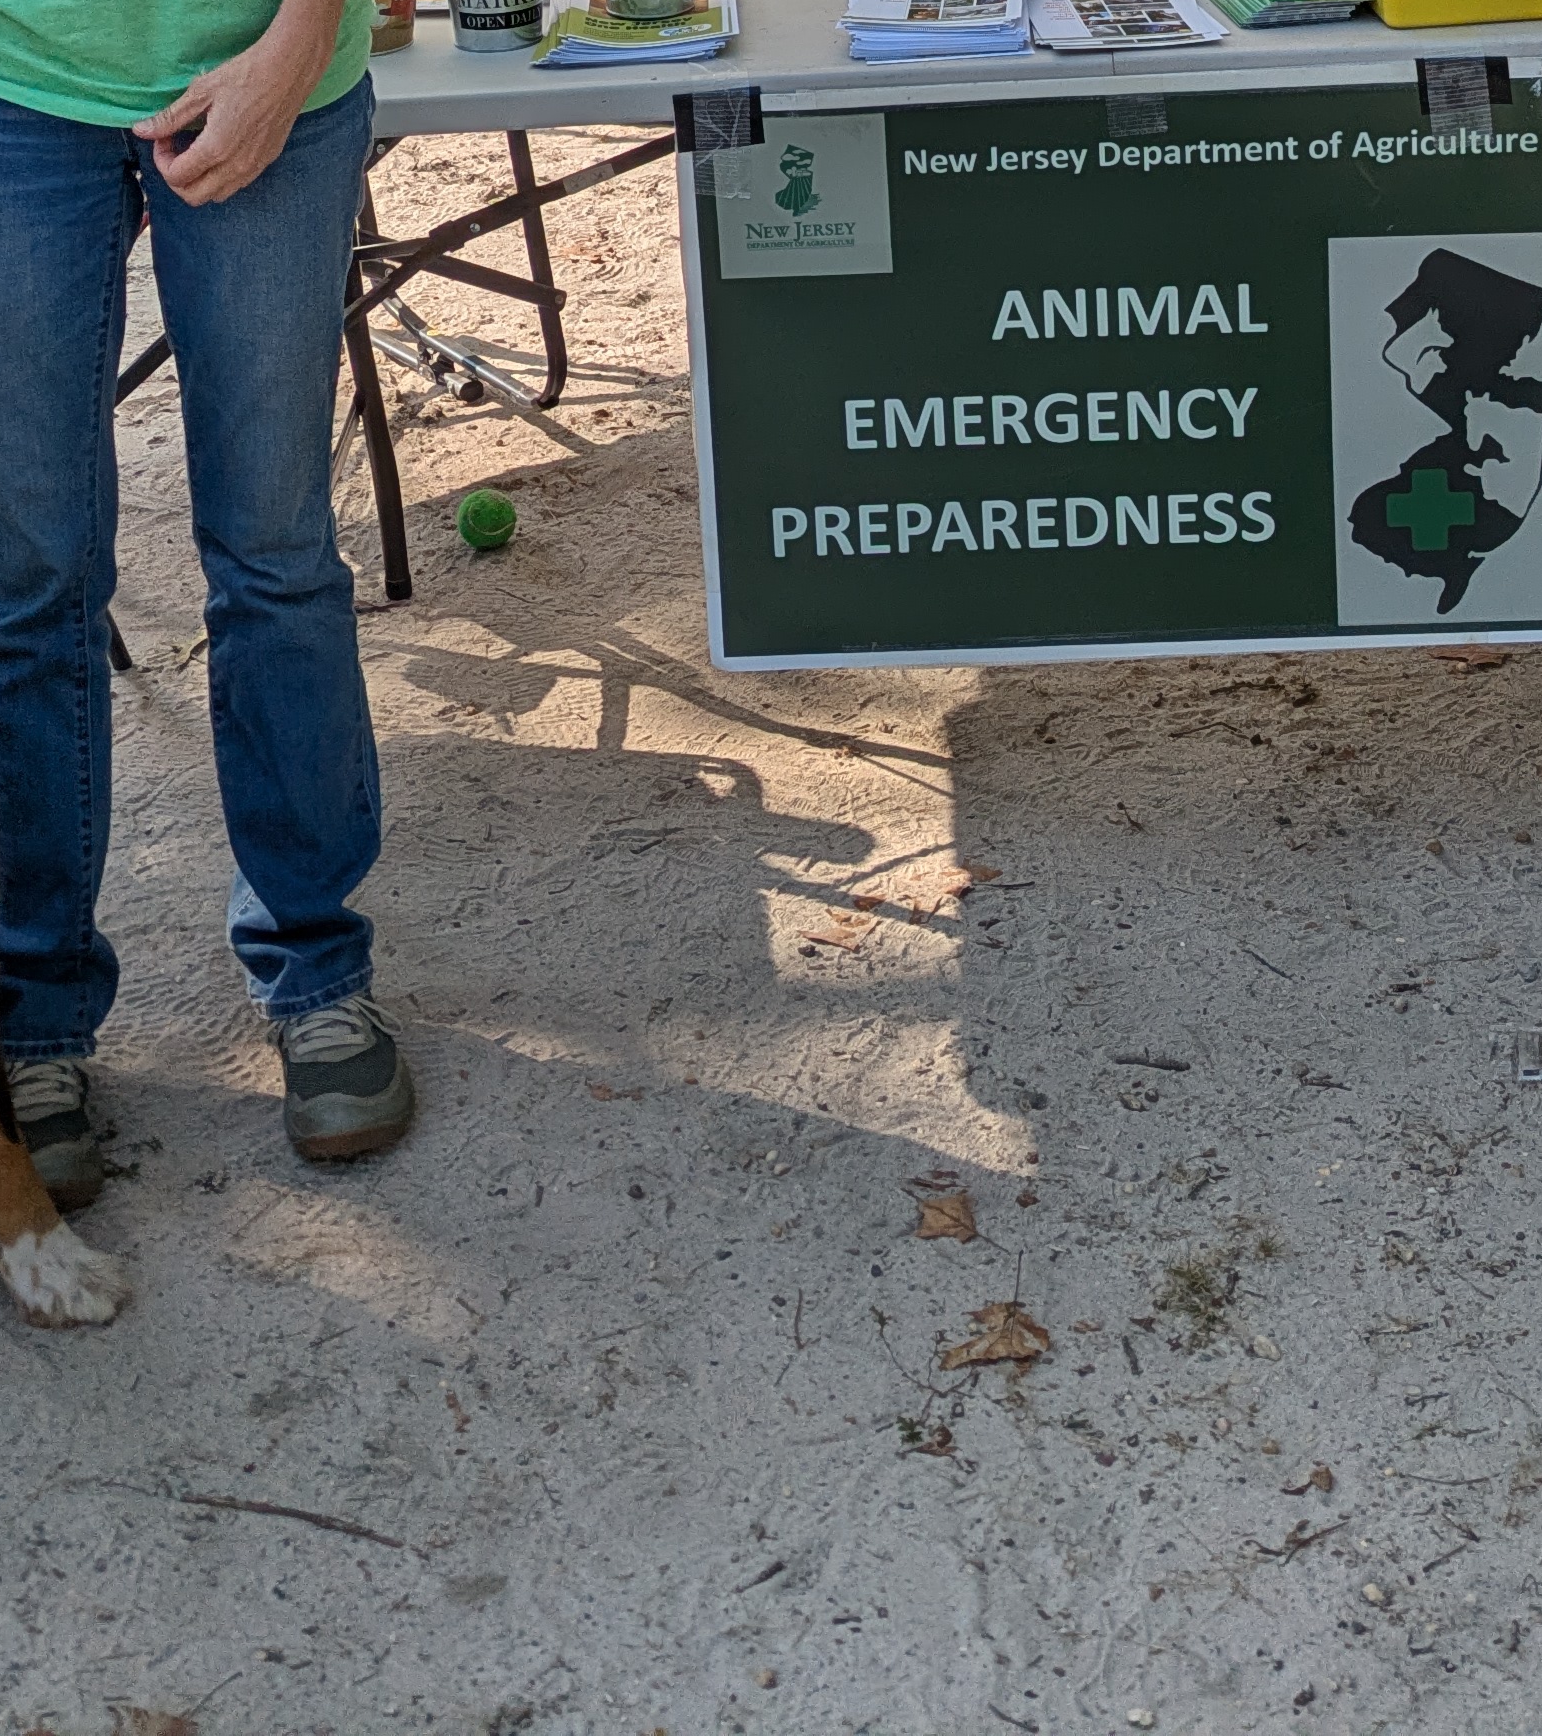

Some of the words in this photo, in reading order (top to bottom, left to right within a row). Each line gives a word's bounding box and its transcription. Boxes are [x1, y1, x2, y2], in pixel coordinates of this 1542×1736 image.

[466, 14, 506, 29] OPEN
[903, 147, 977, 175] New
[986, 143, 1088, 179] Jersey
[1097, 136, 1299, 174] Department
[1307, 131, 1344, 160] of
[1351, 126, 1540, 165] Agriculture
[746, 241, 794, 250] DEPARTMENT
[795, 240, 805, 248] OF
[806, 238, 855, 248] AGRICULTURE
[991, 282, 1269, 342] ANIMAL
[844, 386, 1260, 451] EMERGENCY
[771, 490, 1277, 559] PREPAREDNESS
